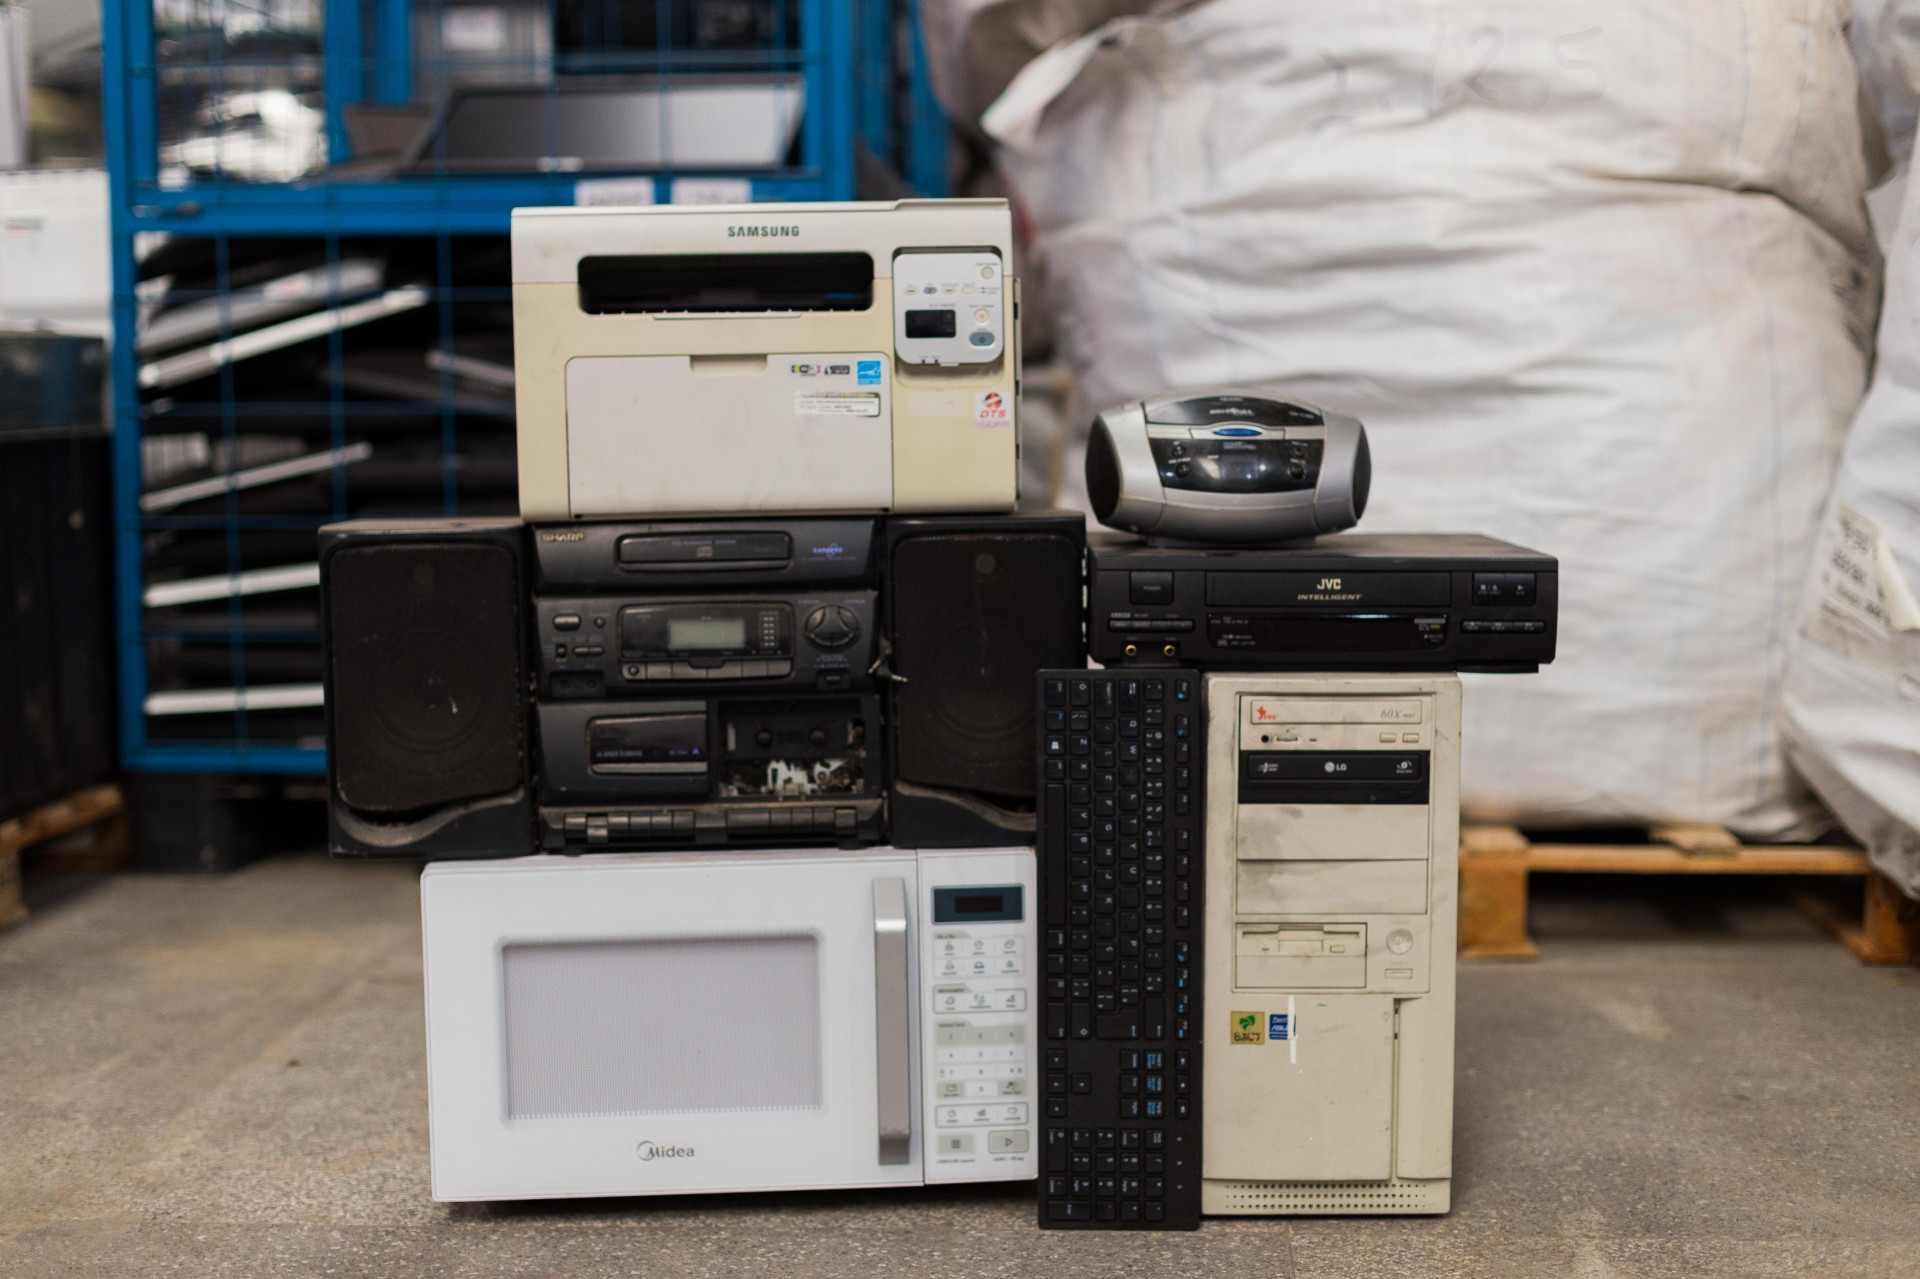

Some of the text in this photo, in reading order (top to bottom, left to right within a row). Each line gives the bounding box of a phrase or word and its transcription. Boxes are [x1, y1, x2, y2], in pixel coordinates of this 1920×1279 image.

[727, 225, 800, 238] SAMSUNG
[1316, 578, 1342, 590] JVC
[1335, 763, 1347, 771] LG
[638, 1140, 695, 1162] Midea
